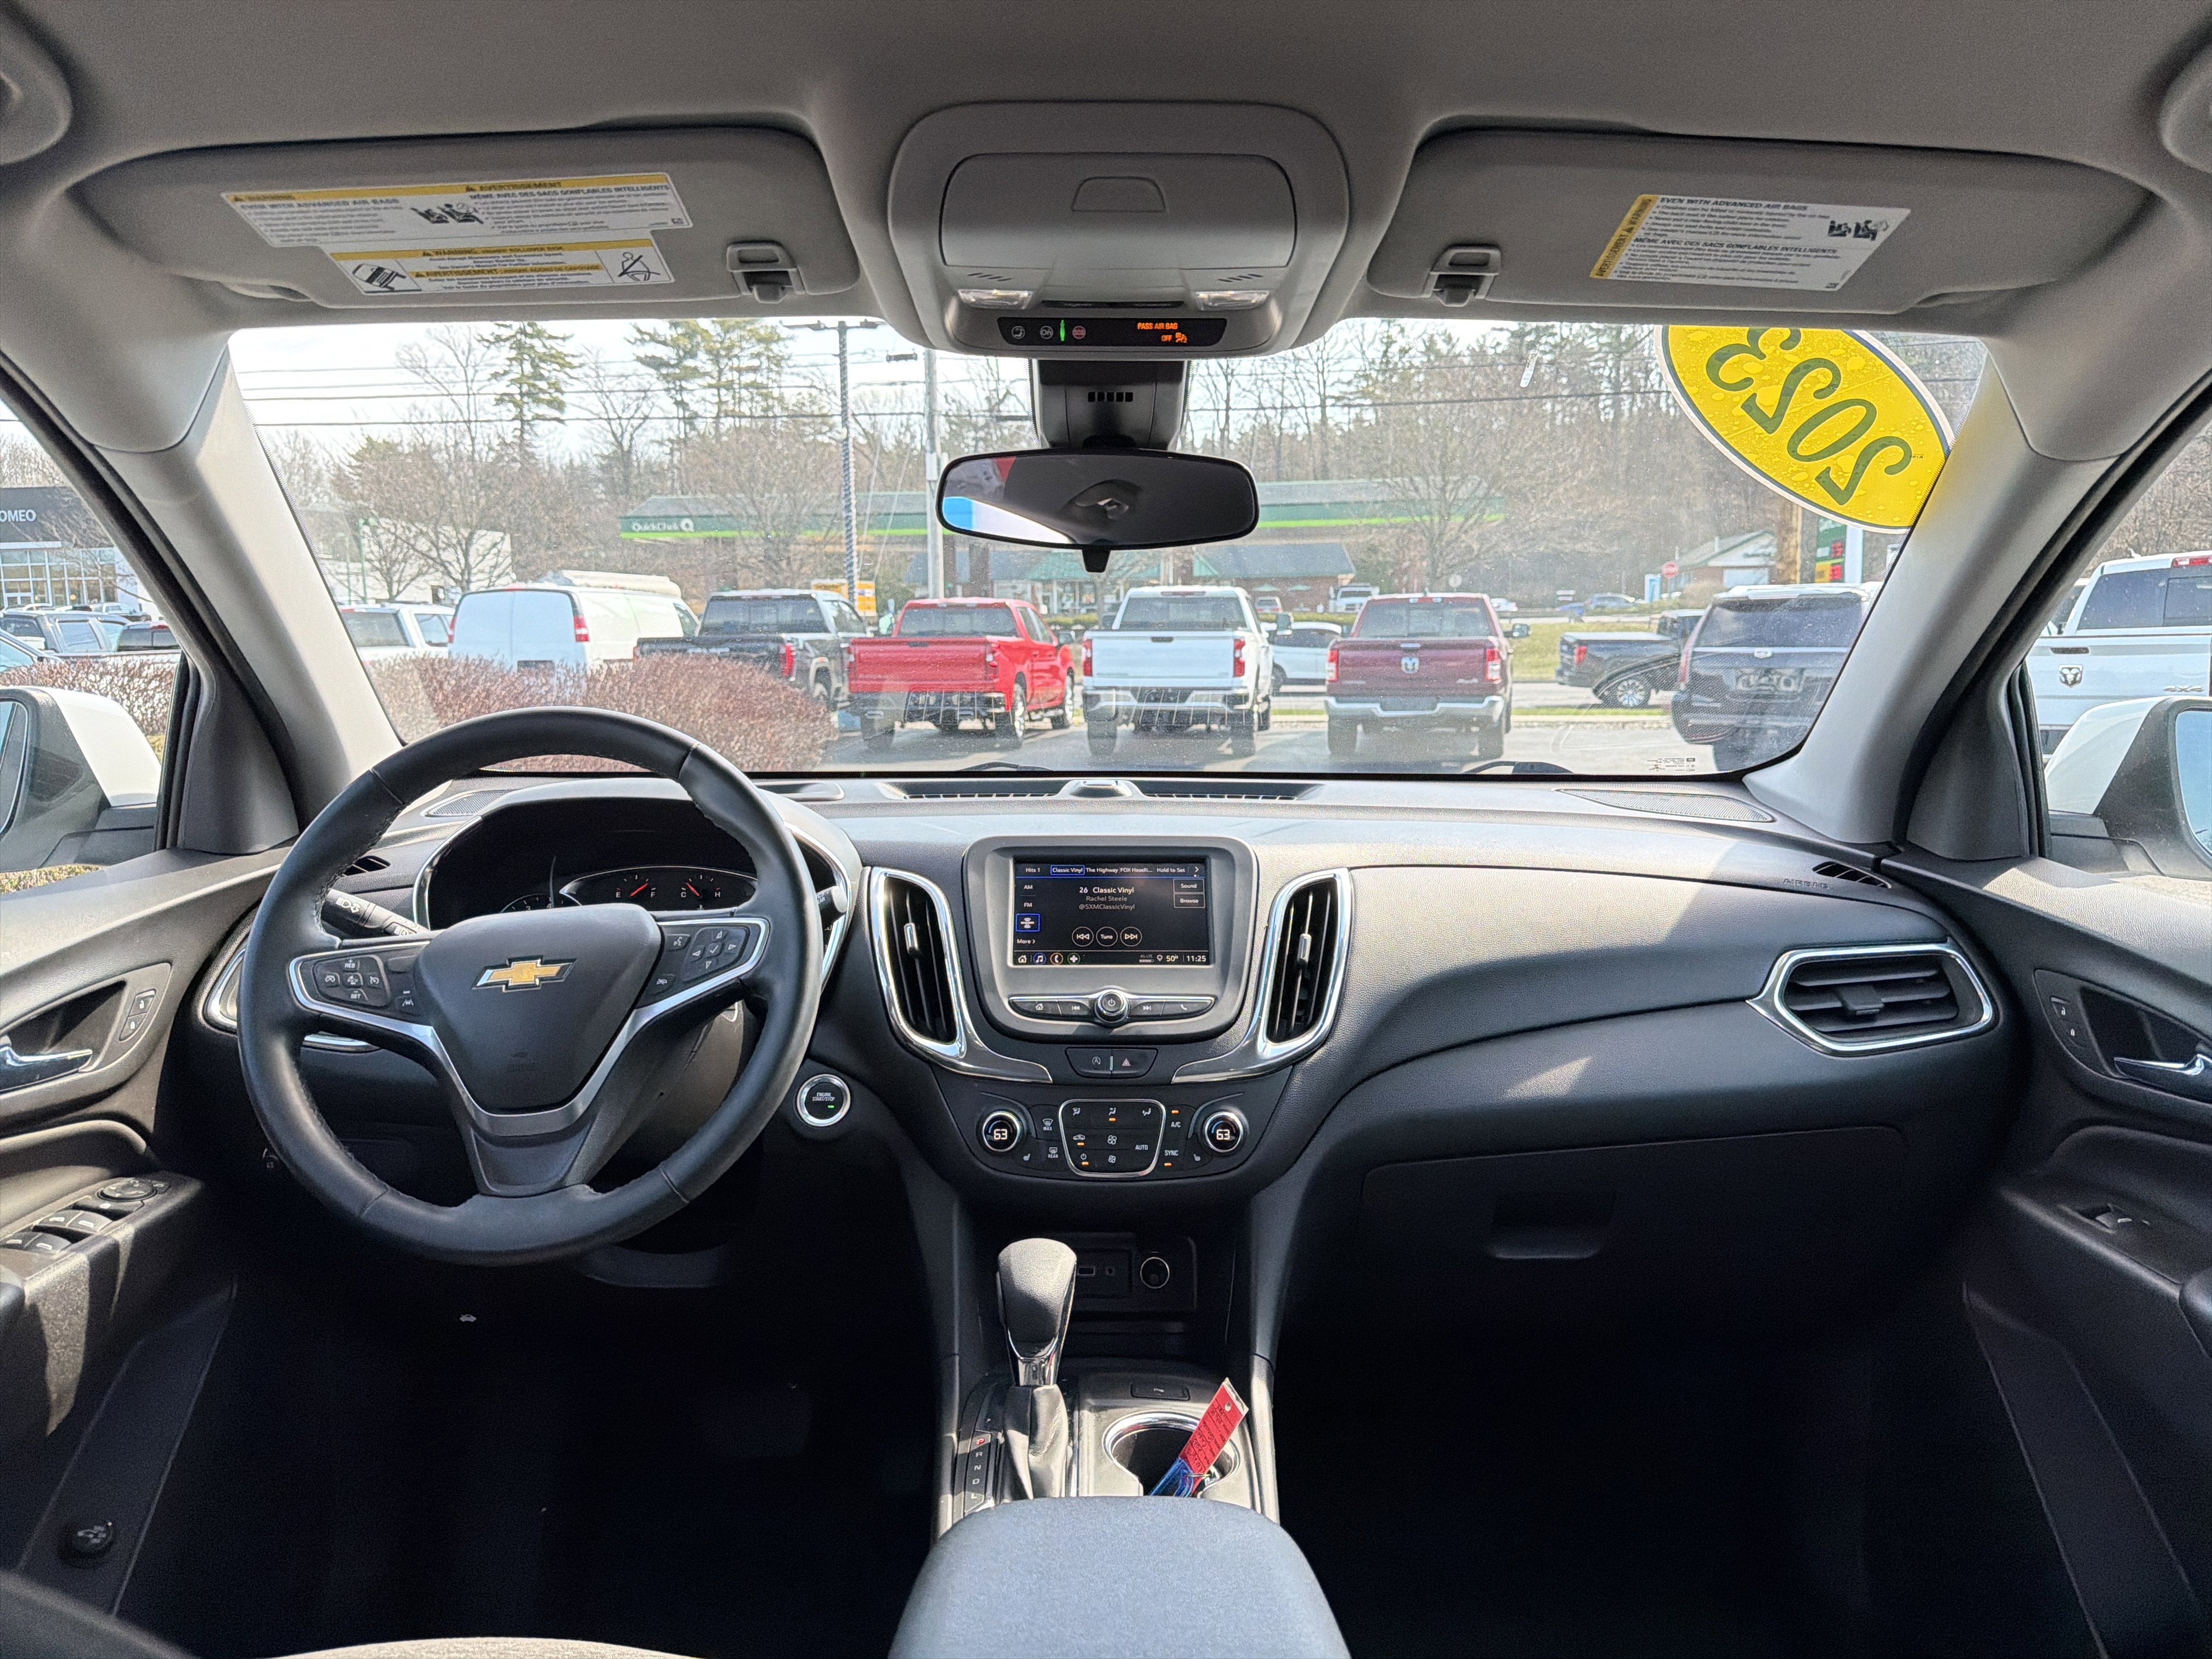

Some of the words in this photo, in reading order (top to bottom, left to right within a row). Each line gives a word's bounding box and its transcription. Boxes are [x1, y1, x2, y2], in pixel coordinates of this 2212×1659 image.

[1712, 200, 1762, 208] ADVANCED
[0, 509, 37, 522] OMEO
[994, 1128, 1008, 1140] 63
[1216, 1128, 1231, 1141] 63
